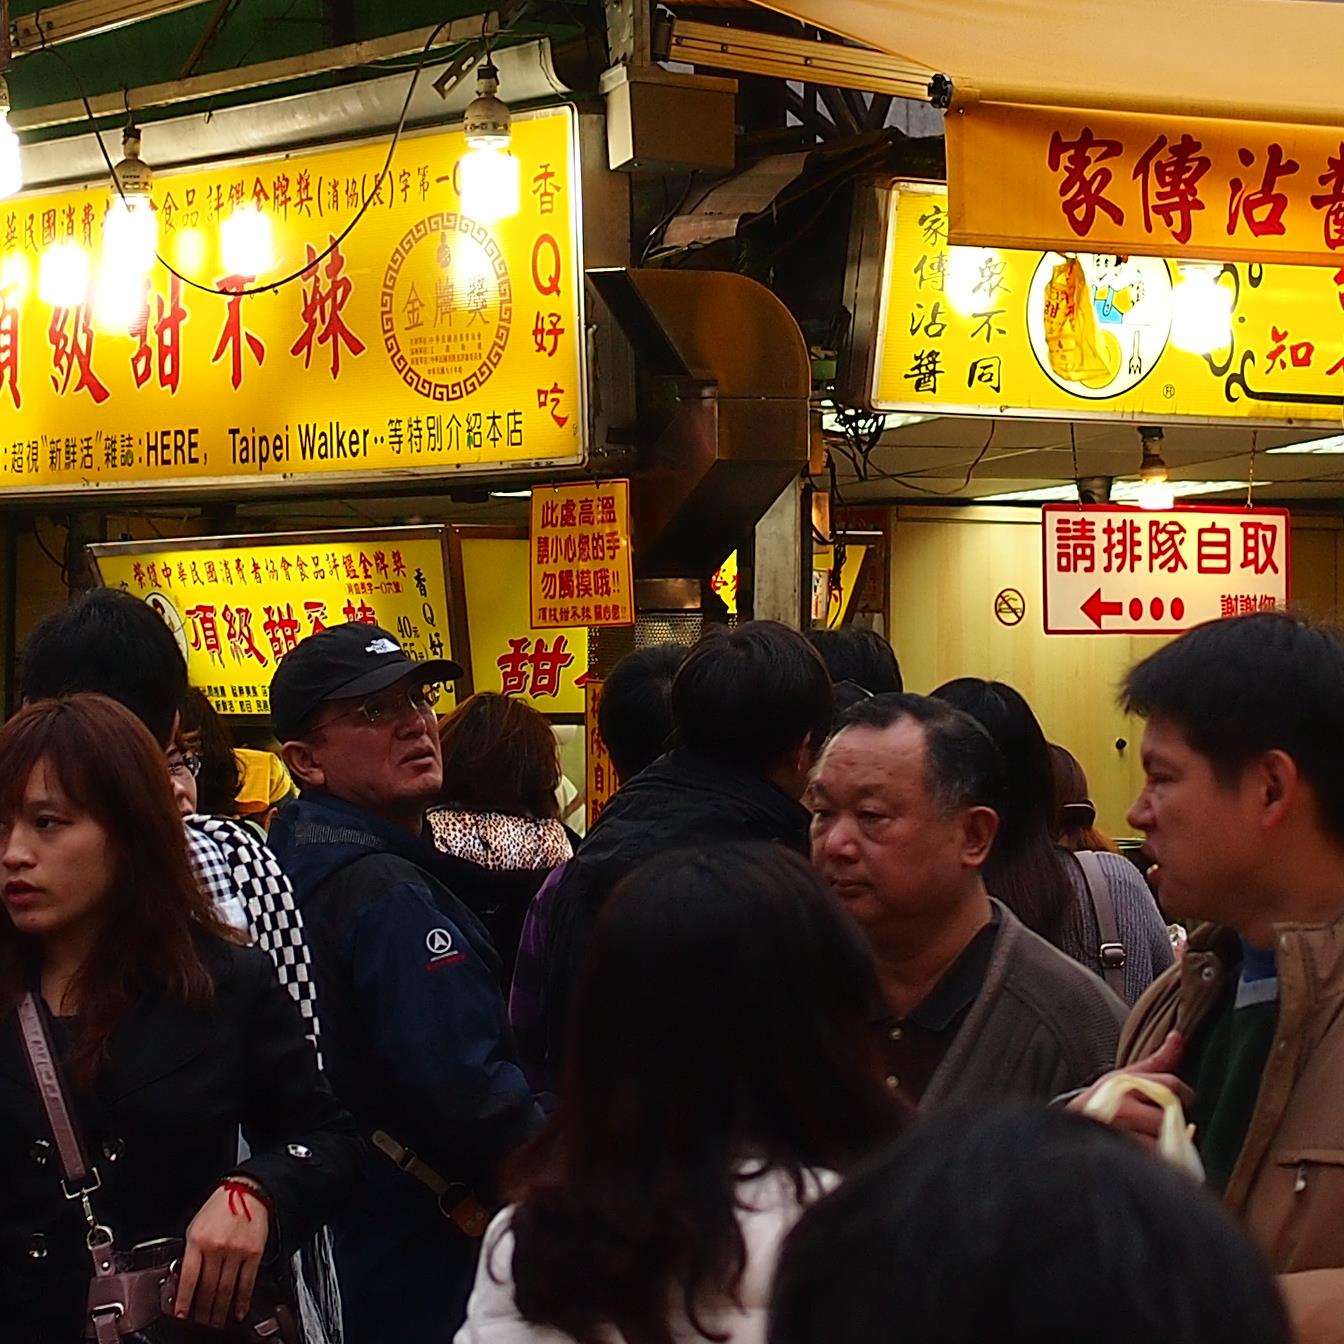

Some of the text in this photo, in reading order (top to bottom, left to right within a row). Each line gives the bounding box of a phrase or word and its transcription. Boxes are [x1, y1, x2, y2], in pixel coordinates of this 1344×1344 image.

[530, 163, 570, 431] 香Q好吃
[904, 205, 950, 394] 家傳沾醬
[228, 425, 291, 471] Taipei
[541, 496, 617, 528] 此處高溫
[537, 531, 620, 564] 請小心您的手
[1056, 518, 1280, 575] 請排隊自取
[397, 615, 420, 638] 40元
